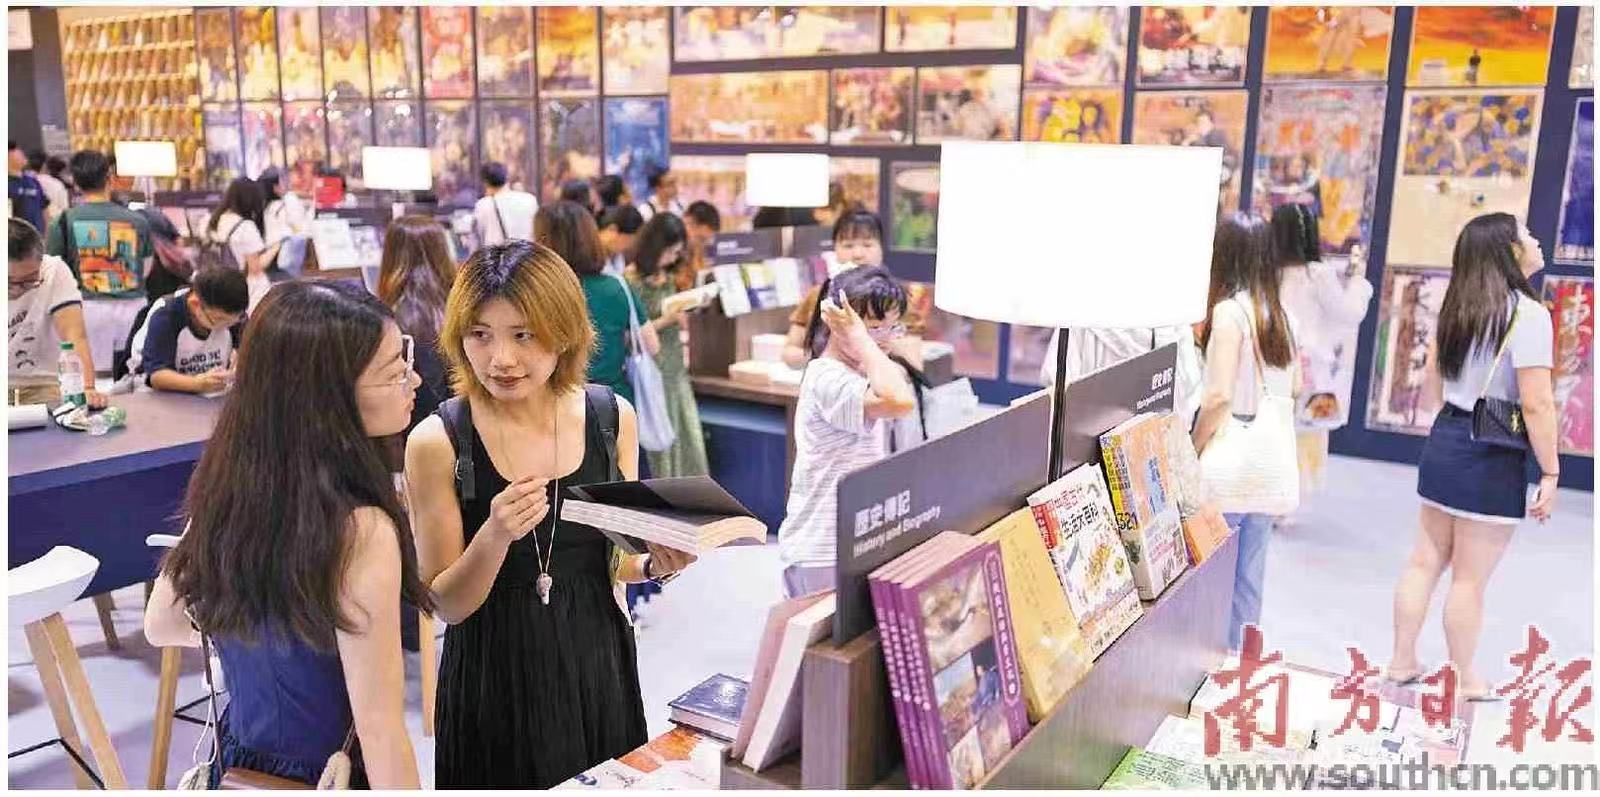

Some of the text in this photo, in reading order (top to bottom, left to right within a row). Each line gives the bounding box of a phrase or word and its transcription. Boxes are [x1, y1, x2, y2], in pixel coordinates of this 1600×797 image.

[853, 505, 941, 559] History and Biography
[854, 489, 911, 538] 歷史傳記
[1061, 501, 1100, 540] 生活大百科
